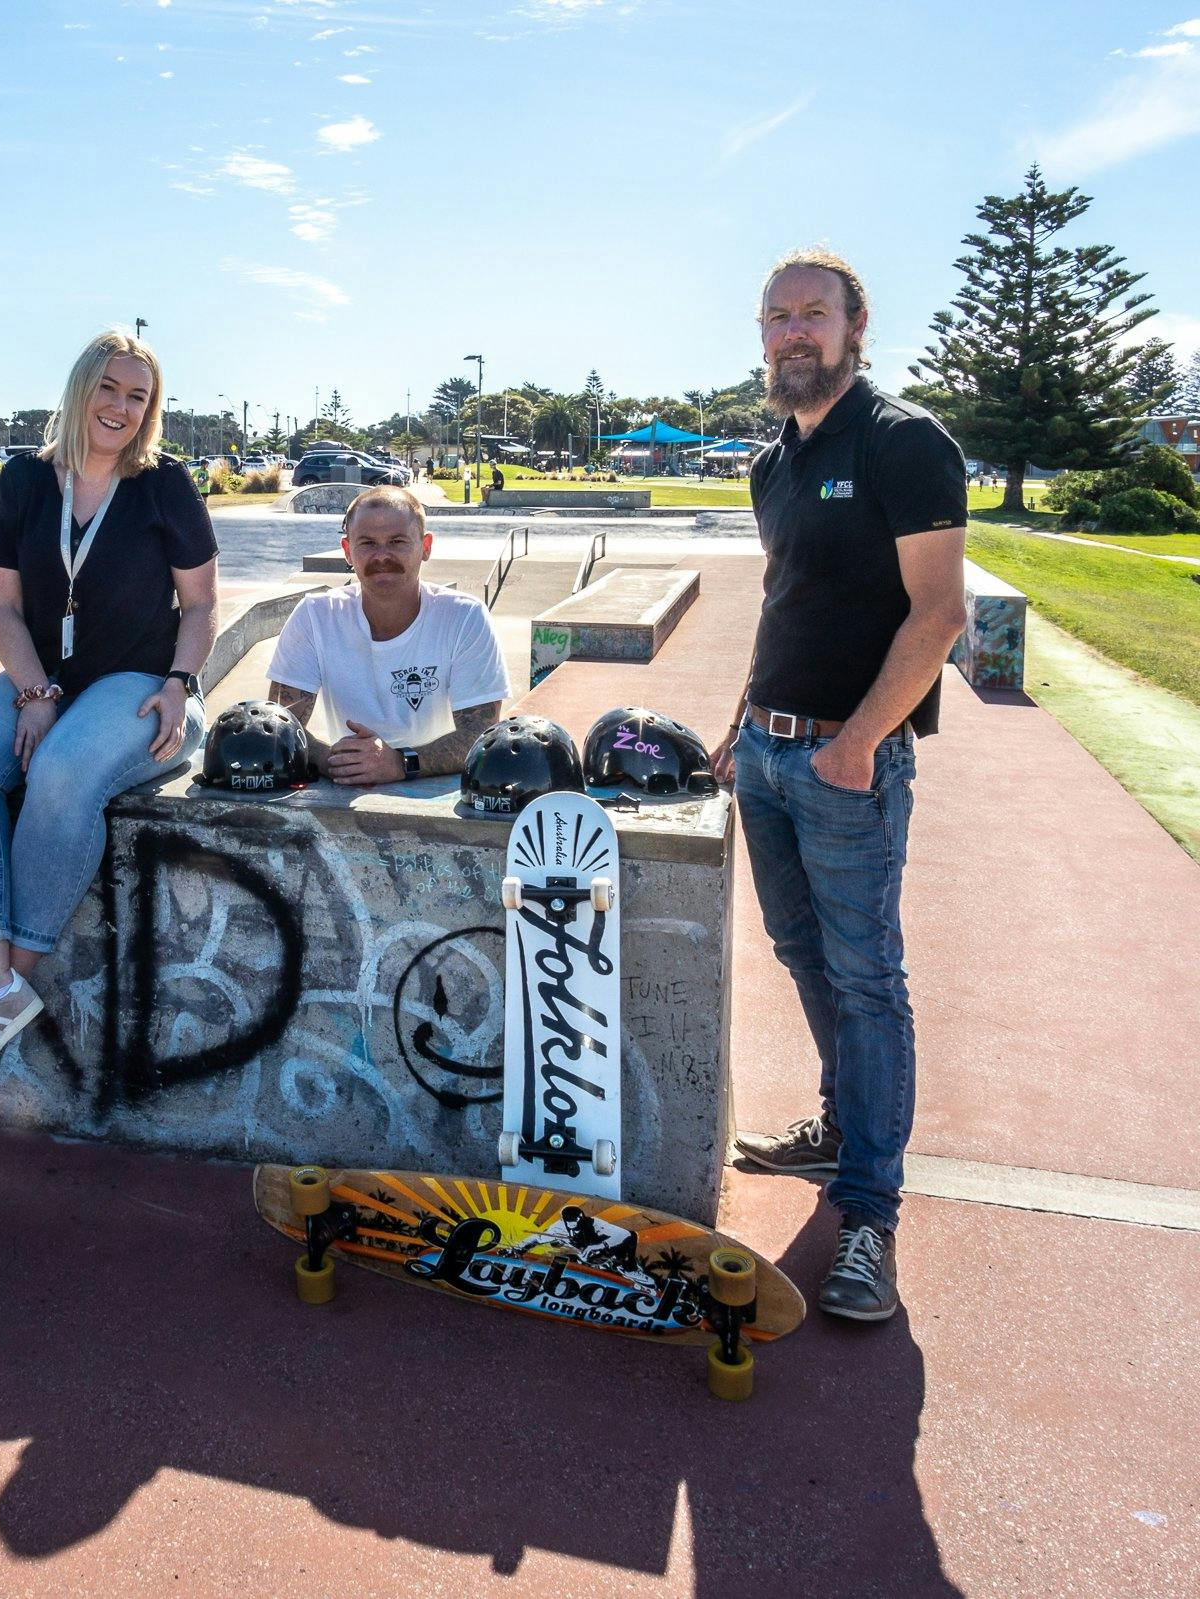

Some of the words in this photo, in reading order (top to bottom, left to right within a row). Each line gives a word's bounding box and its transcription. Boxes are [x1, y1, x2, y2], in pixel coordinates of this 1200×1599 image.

[397, 666, 418, 679] DROP
[420, 667, 431, 676] IN
[617, 725, 629, 733] the
[612, 731, 665, 759] Zone
[553, 811, 568, 866] Australia
[620, 976, 689, 1005] TUNE
[403, 1216, 703, 1328] Layback
[540, 1295, 667, 1334] longboards
